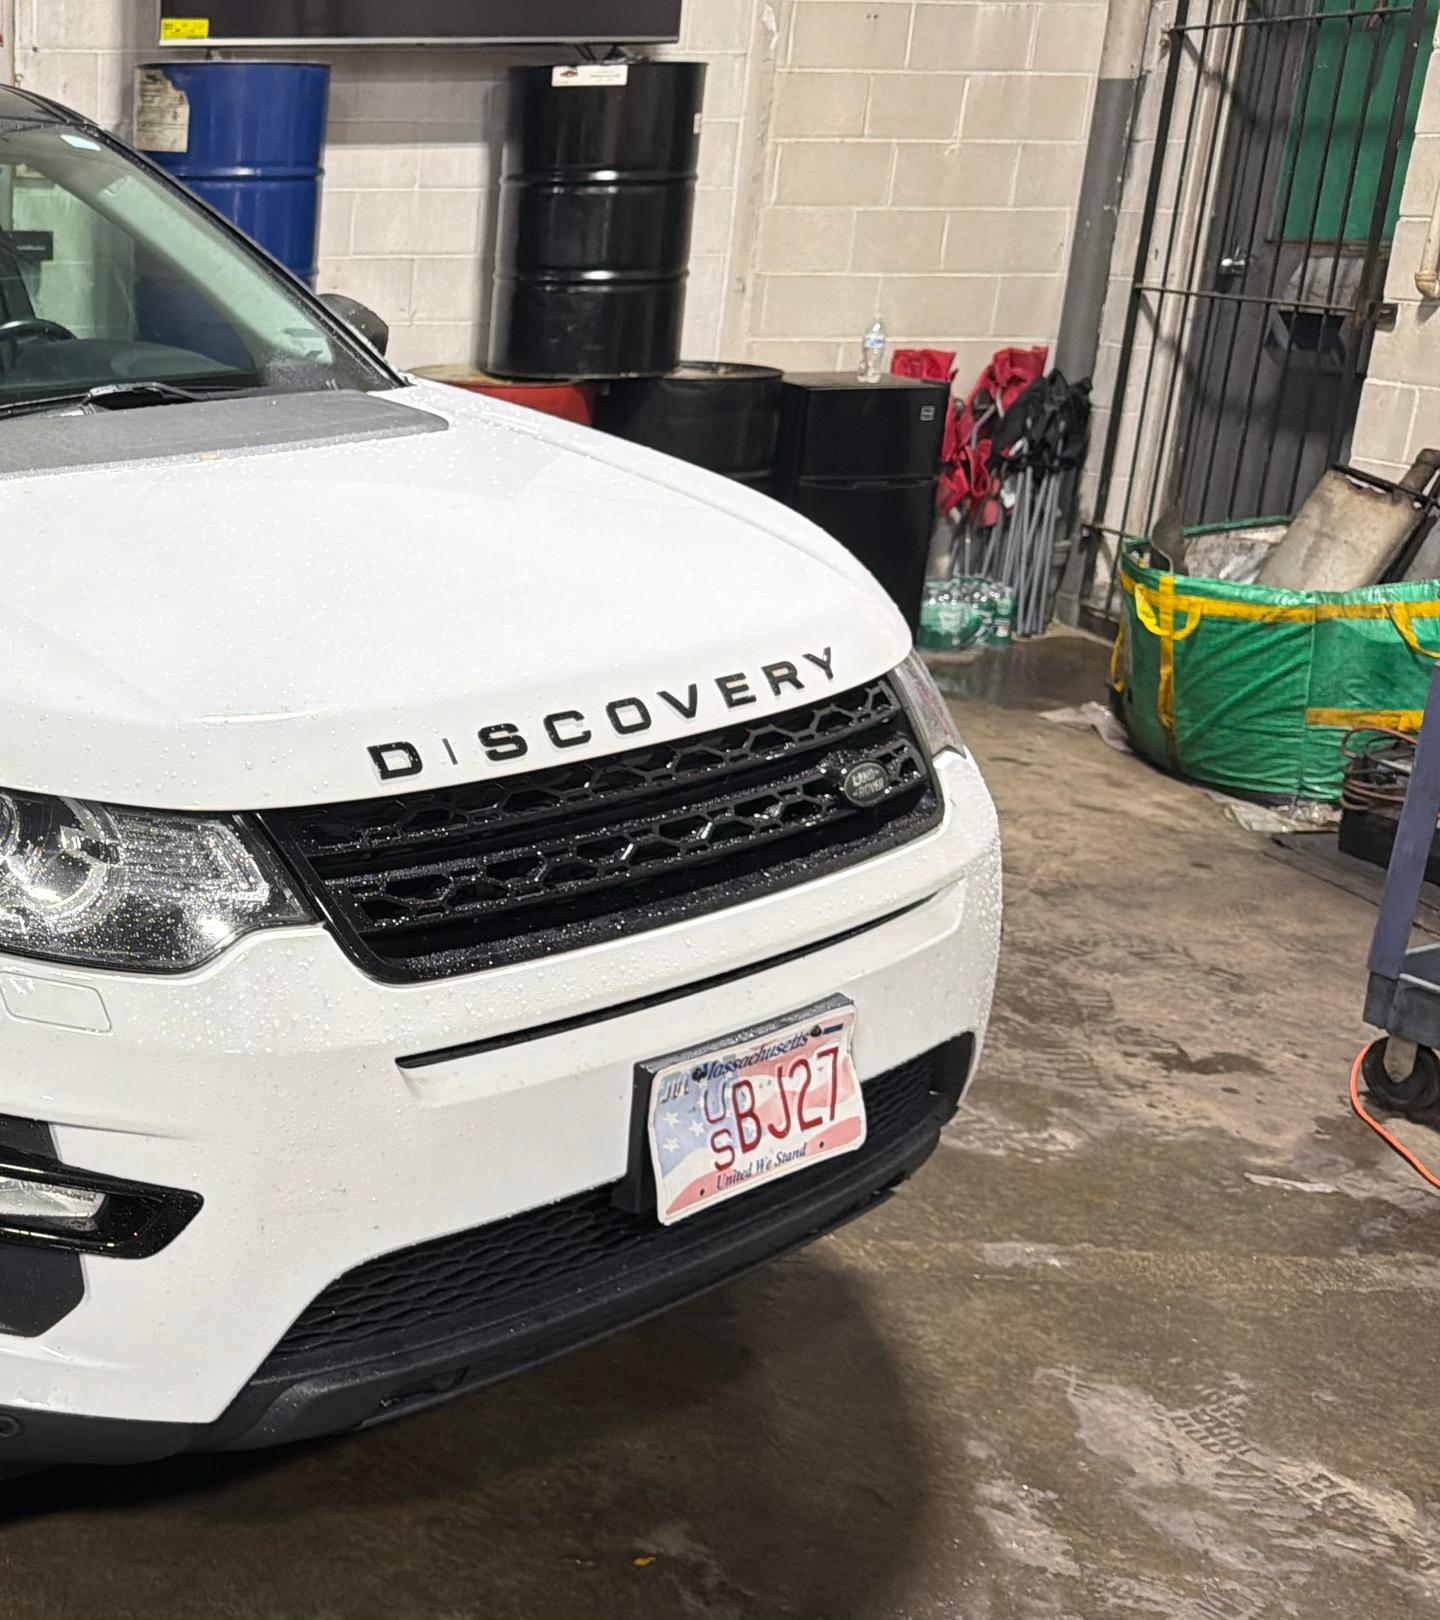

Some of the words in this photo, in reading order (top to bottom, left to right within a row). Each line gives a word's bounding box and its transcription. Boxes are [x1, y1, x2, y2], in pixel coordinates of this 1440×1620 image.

[367, 646, 834, 780] DISCOVERY
[716, 1161, 753, 1190] United
[756, 1157, 772, 1173] We
[774, 1142, 807, 1167] Stand
